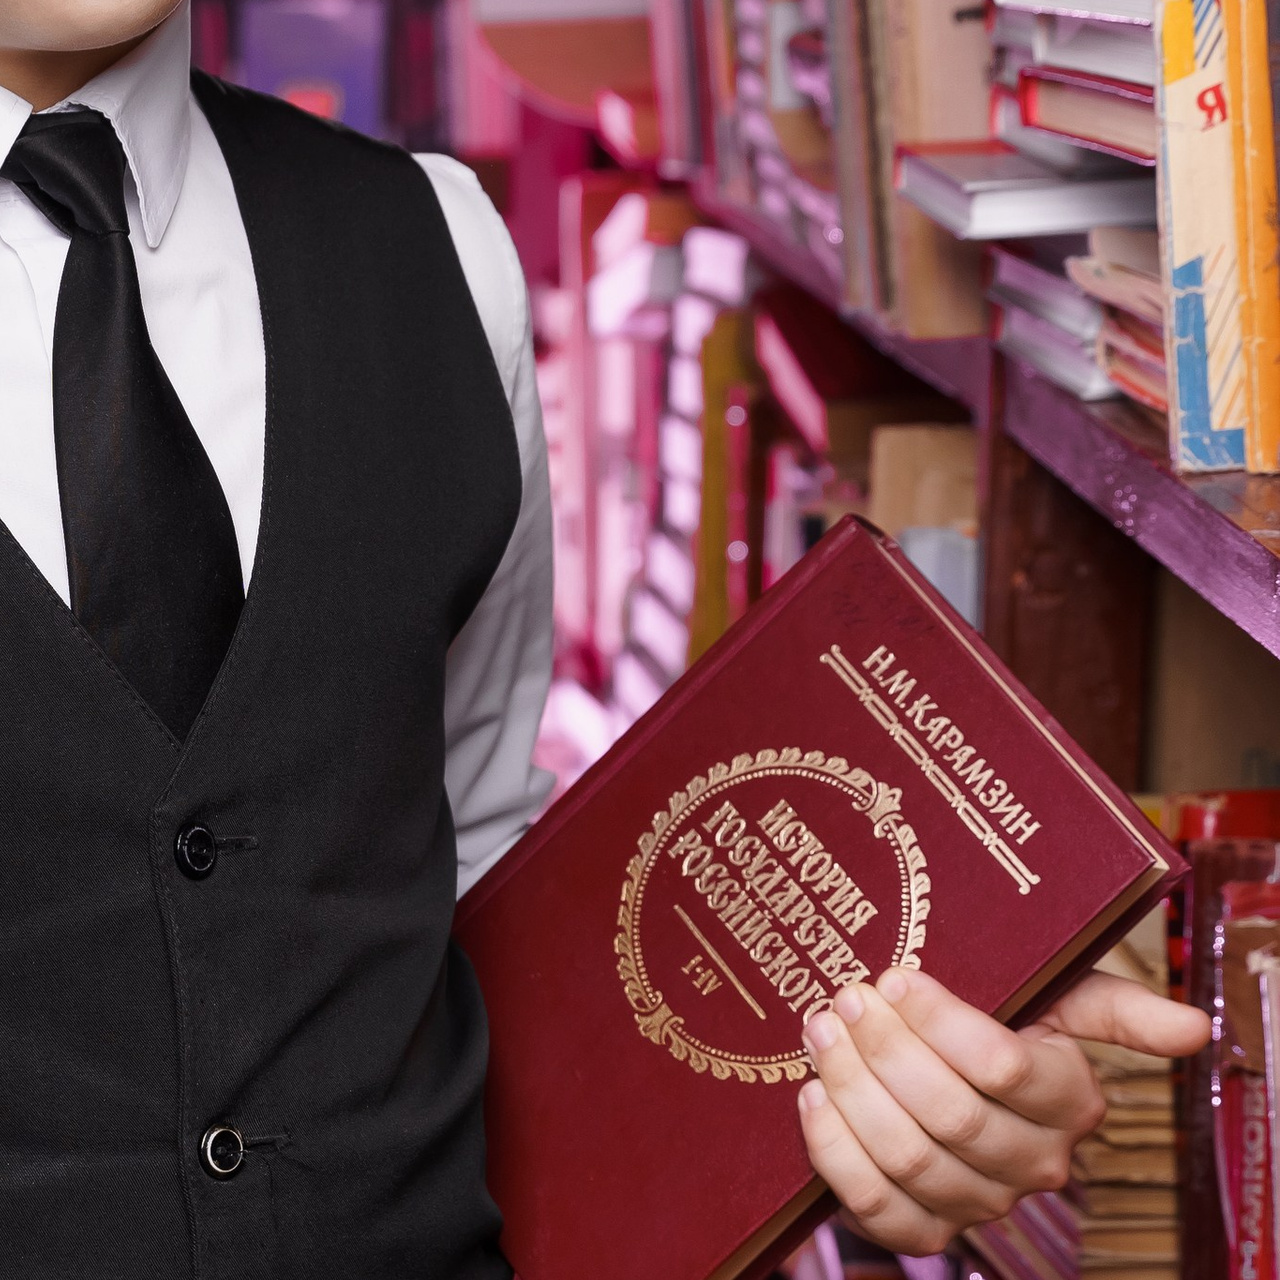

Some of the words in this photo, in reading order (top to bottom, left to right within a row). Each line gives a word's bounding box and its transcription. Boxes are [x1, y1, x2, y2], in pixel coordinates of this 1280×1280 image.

[1197, 83, 1229, 132] Я
[701, 799, 871, 987] ГОСУДАРСТВА
[757, 798, 879, 936] ИСТОРИЯ
